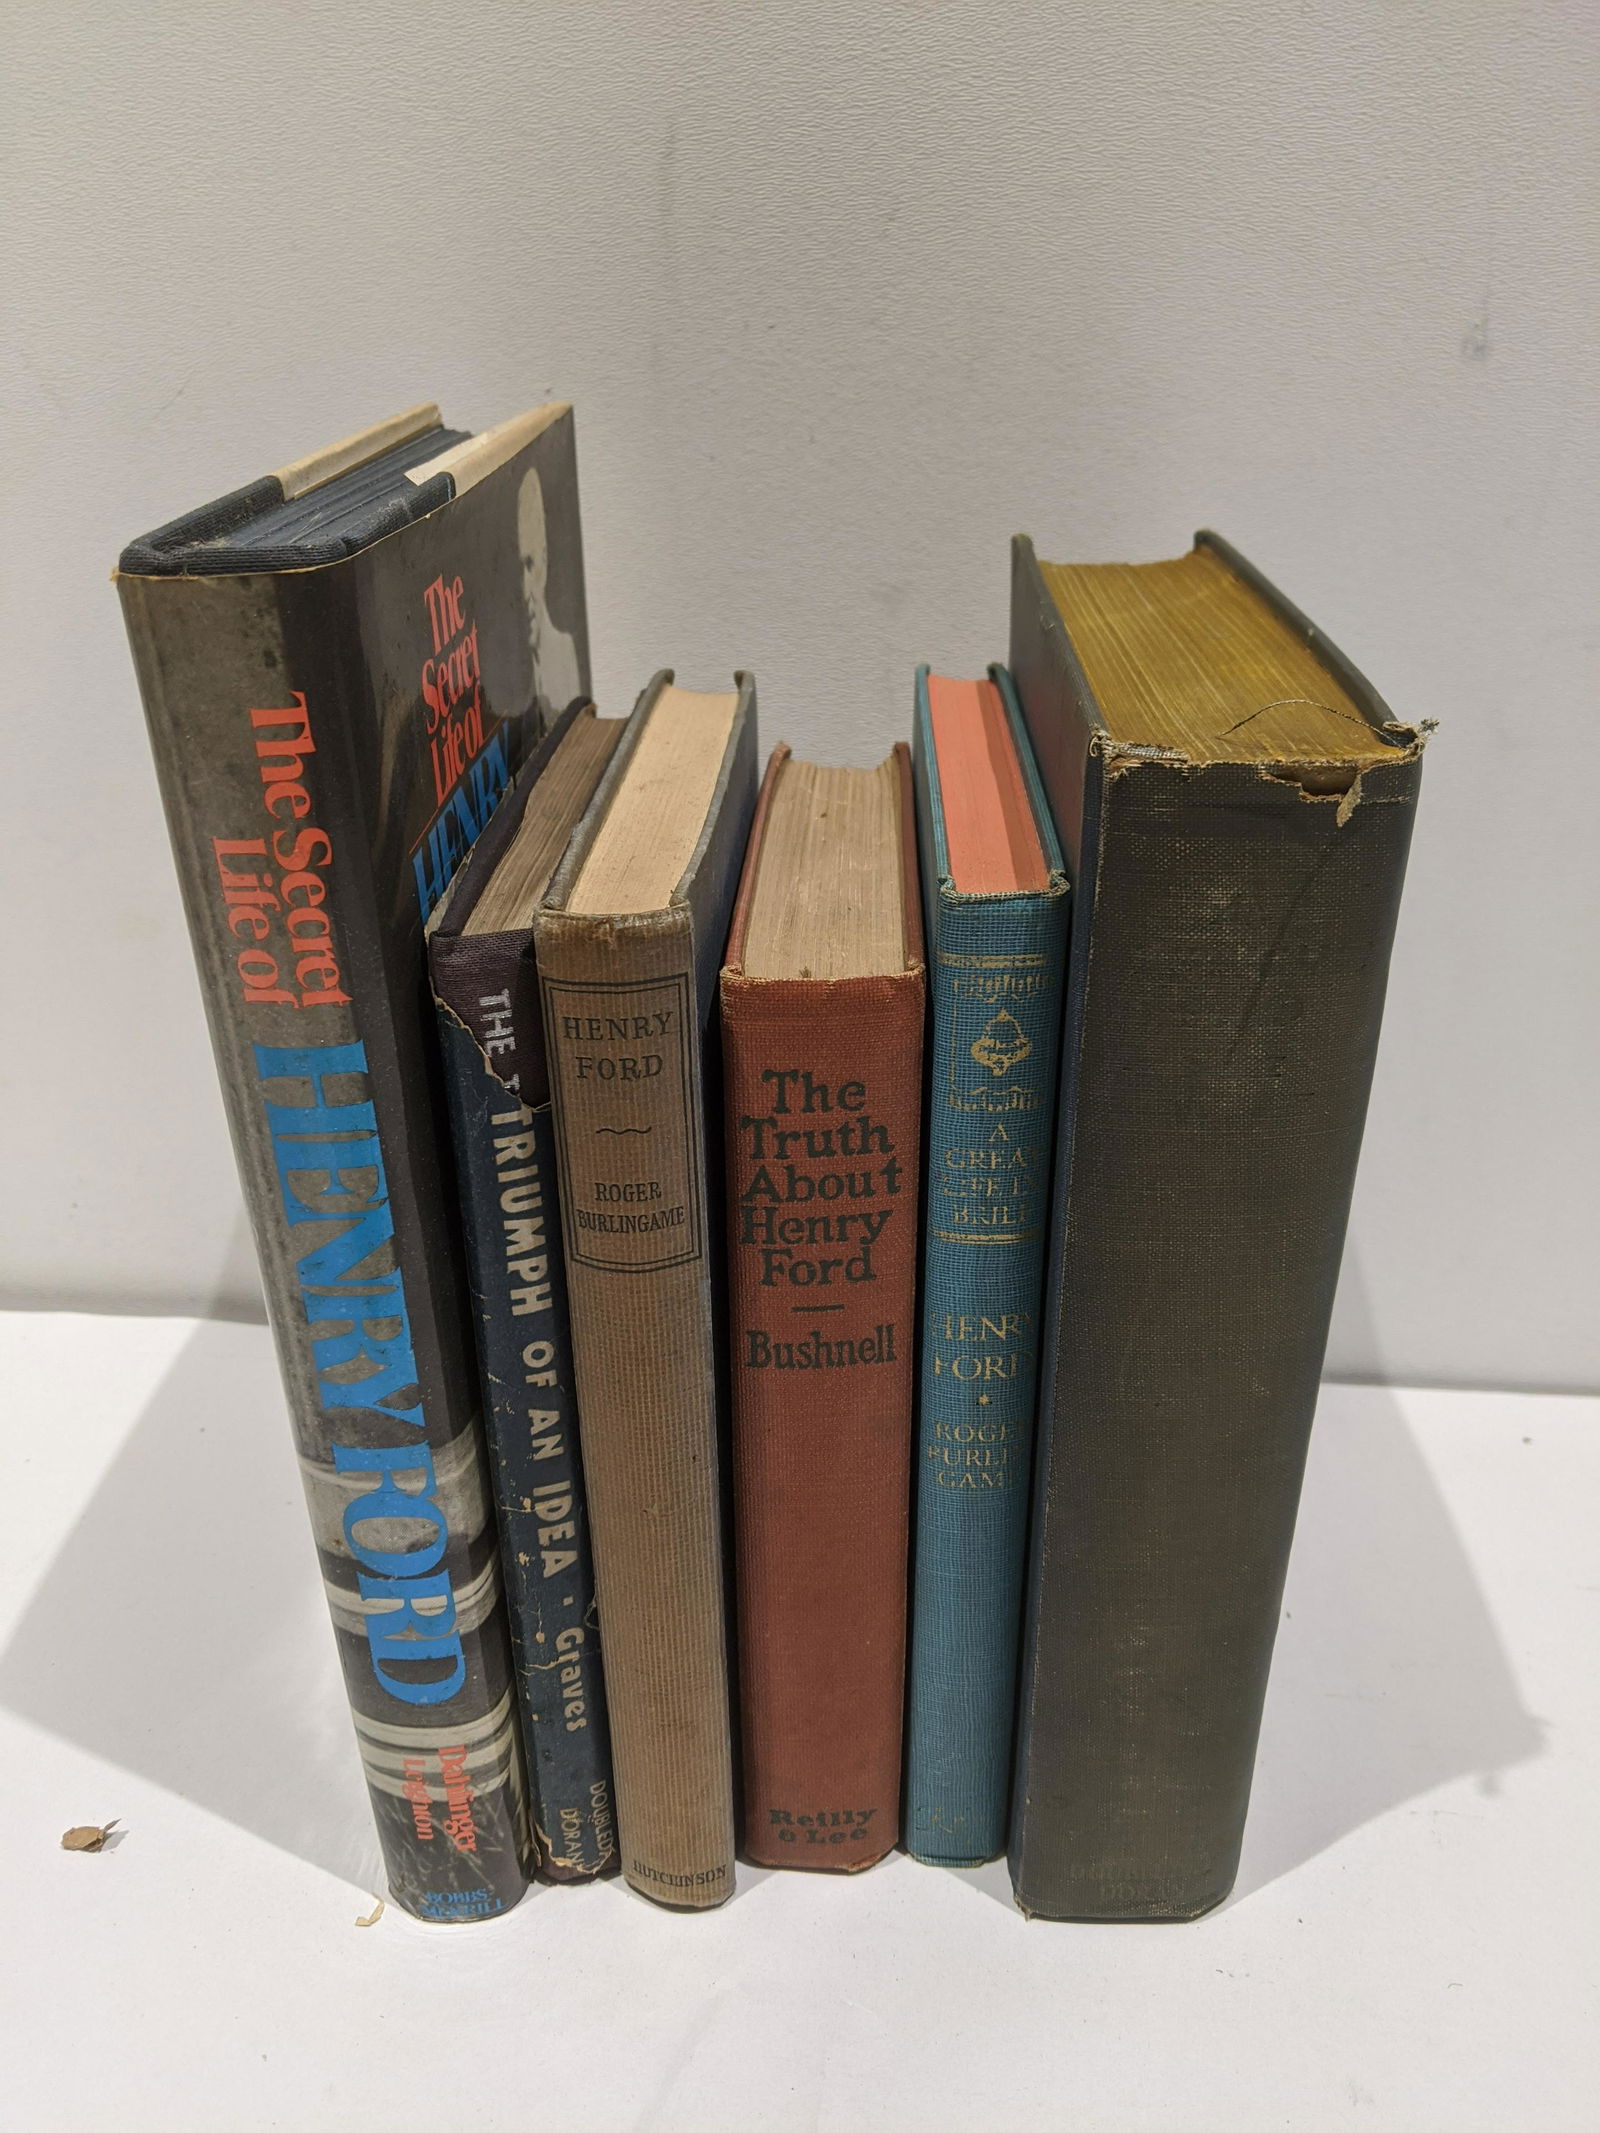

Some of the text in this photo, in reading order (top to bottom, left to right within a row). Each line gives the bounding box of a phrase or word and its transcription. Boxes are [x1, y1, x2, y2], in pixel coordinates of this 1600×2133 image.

[424, 574, 464, 656] The
[422, 618, 481, 735] Secret
[431, 679, 486, 808] Life of
[250, 691, 353, 1009] The Secret
[212, 835, 302, 1010] Life of
[479, 987, 517, 1057] THE
[563, 1011, 674, 1041] HENRY
[576, 1054, 664, 1081] FORD
[762, 1069, 867, 1115] The
[741, 1115, 895, 1160] Truth
[987, 1122, 1009, 1142] A
[594, 1182, 662, 1202] ROGER
[741, 1156, 903, 1202] About
[577, 1206, 686, 1234] BURLINGAME
[738, 1204, 894, 1246] Henry
[759, 1247, 876, 1287] Ford
[491, 1103, 579, 1580] TRIUMPH OF AN IDEA
[746, 1324, 896, 1370] Bushnell
[252, 1038, 468, 1706] HENRY FORD
[555, 1626, 588, 1733] Graves
[438, 1744, 477, 1851] Dahlinger
[768, 1809, 879, 1828] Reilly
[806, 1828, 869, 1844] Lee
[633, 1860, 727, 1888] HUTCHINSON
